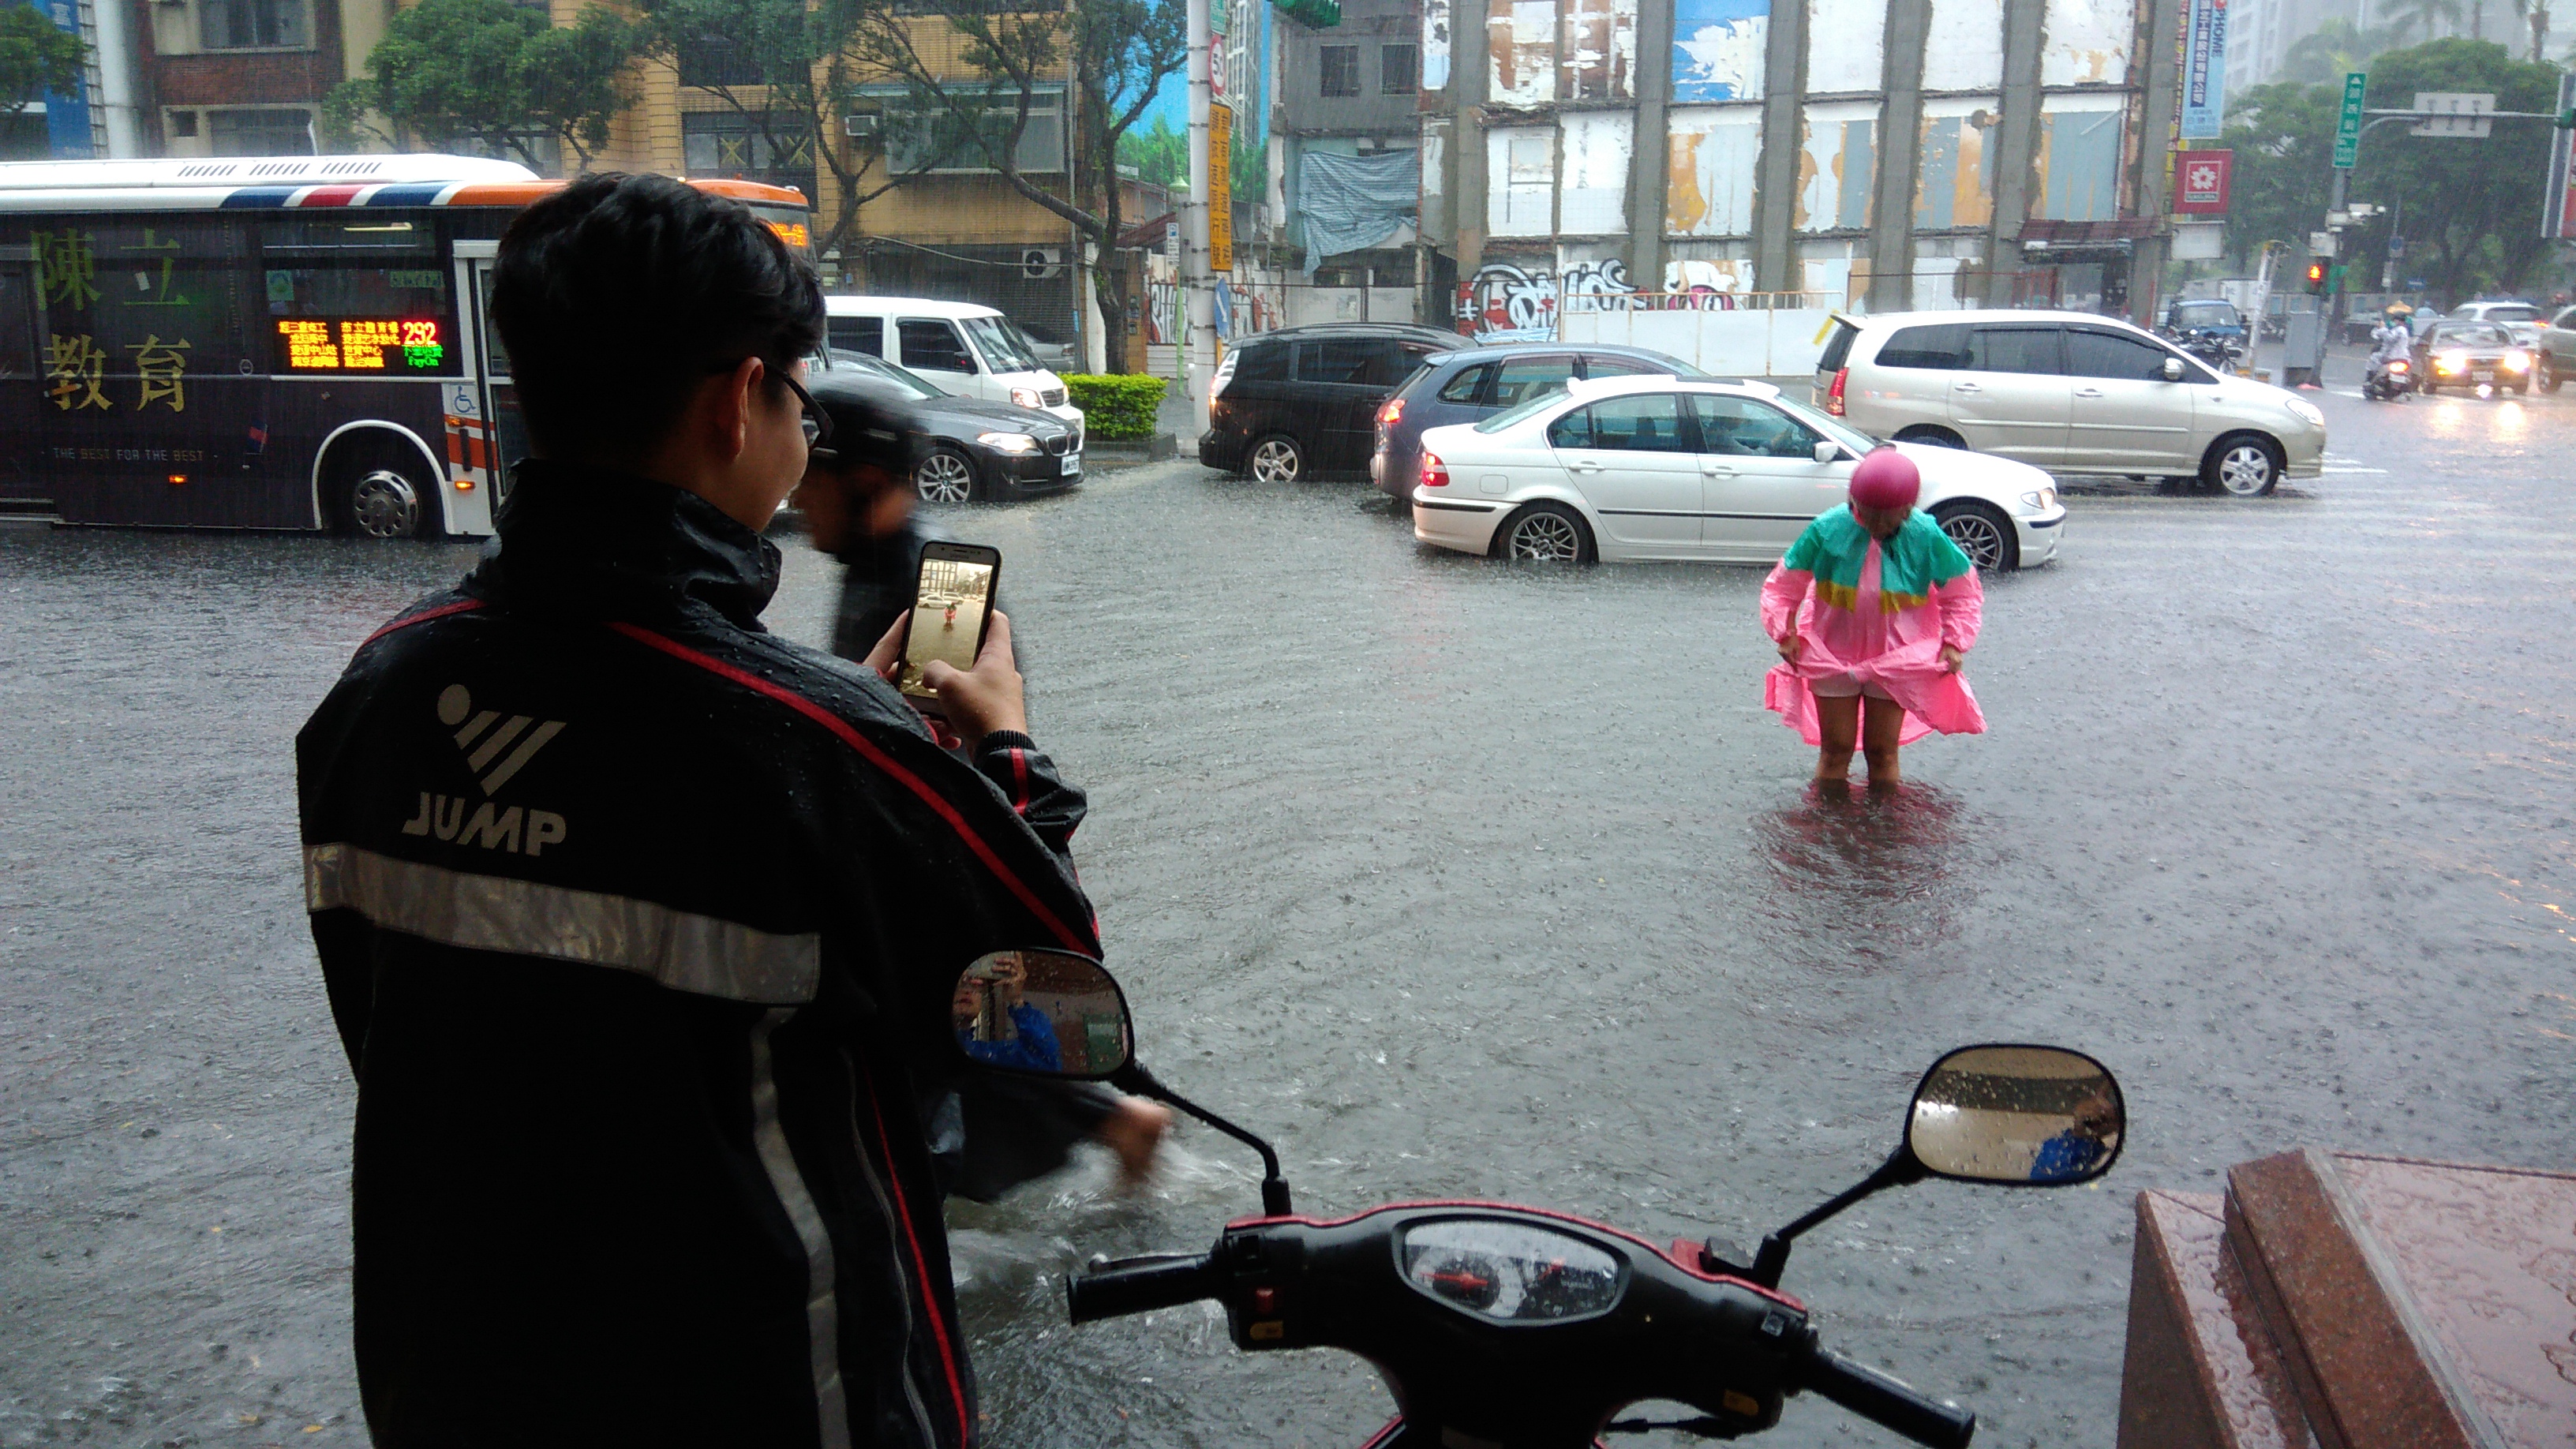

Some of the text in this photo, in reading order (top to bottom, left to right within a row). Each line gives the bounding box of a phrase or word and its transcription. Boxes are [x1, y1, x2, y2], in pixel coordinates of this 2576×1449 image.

[30, 227, 190, 311] 陳立
[402, 321, 436, 345] 292
[43, 333, 192, 413] 教育
[53, 447, 204, 462] THE BEST FOR THE BEST
[401, 791, 567, 856] JUMP
